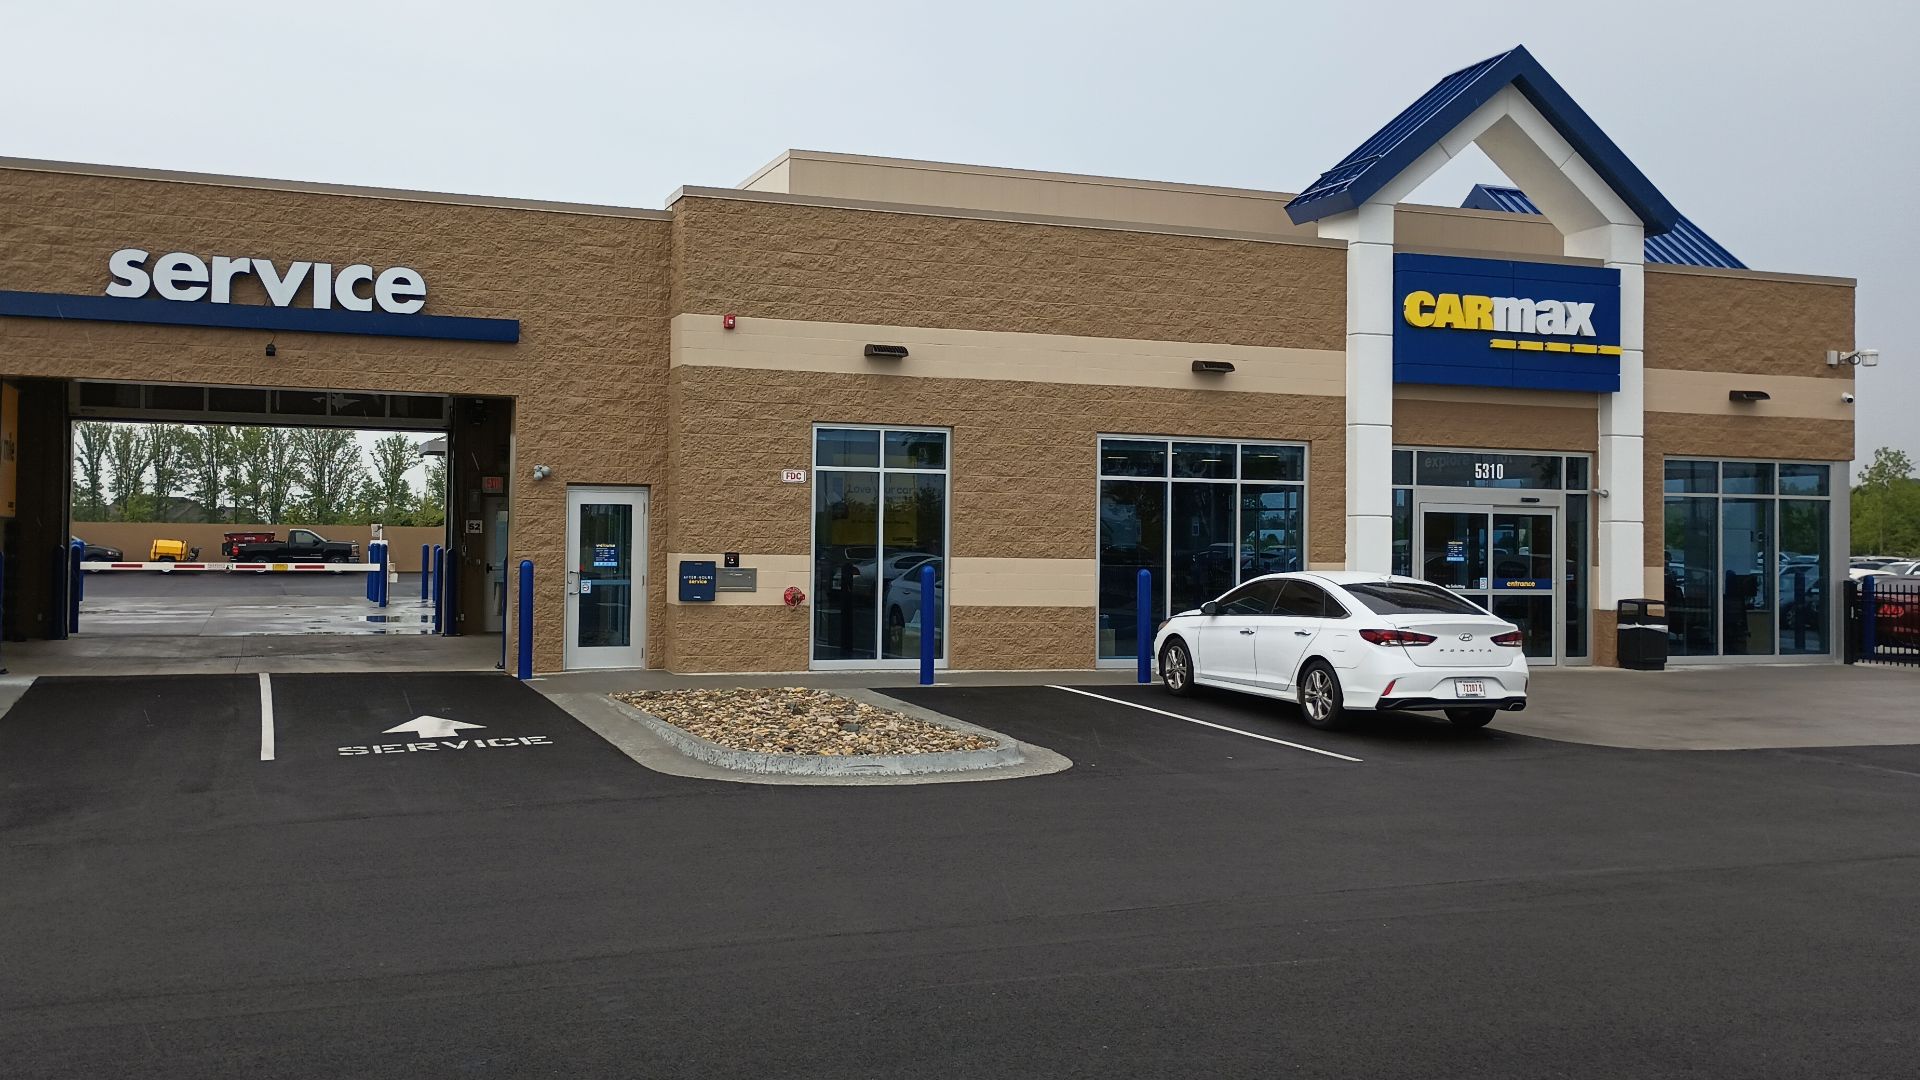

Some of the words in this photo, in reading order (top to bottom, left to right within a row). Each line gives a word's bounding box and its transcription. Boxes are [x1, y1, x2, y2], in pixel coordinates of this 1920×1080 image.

[105, 248, 426, 314] service
[786, 472, 802, 480] FDC
[1474, 463, 1504, 480] 5310
[847, 484, 872, 494] Love
[337, 735, 554, 756] SERVICE
